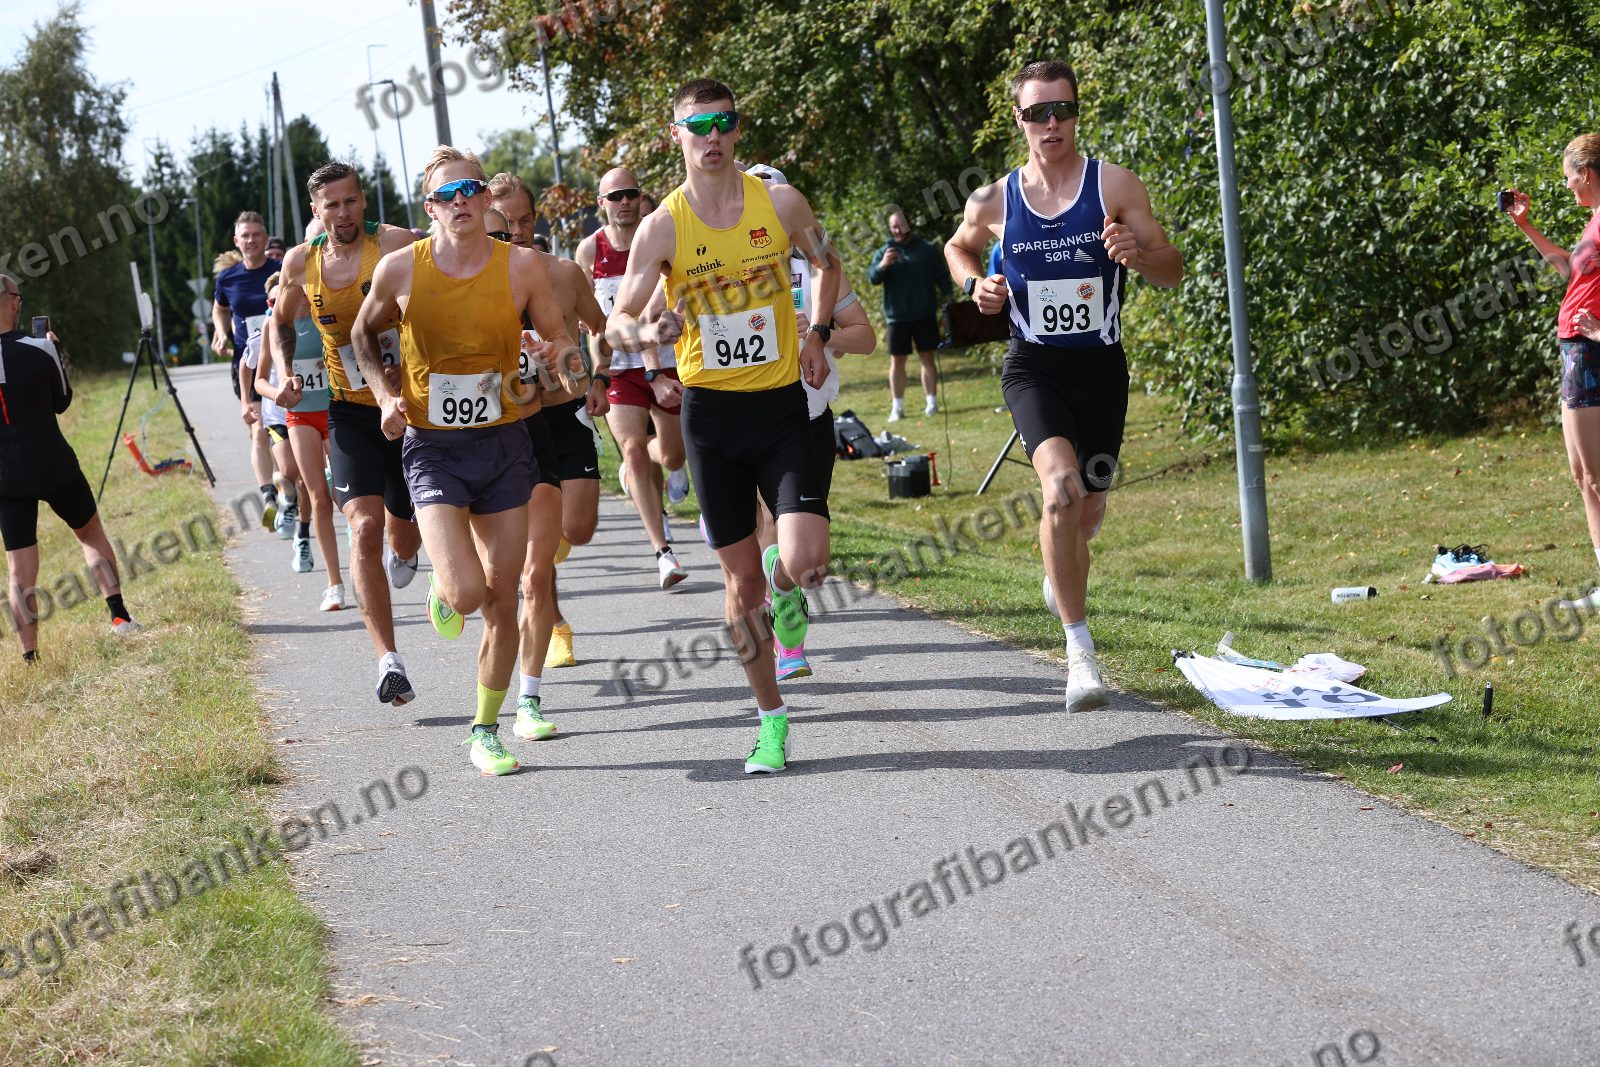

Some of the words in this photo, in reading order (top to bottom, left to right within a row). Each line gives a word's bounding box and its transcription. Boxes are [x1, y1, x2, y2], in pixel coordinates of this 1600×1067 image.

[1012, 231, 1100, 253] SPAREBANKEN
[686, 258, 725, 276] rethink.
[1045, 250, 1071, 262] SØR
[1042, 304, 1091, 333] 993
[716, 335, 767, 366] 942
[442, 397, 488, 424] 992
[420, 489, 443, 500] HOKA
